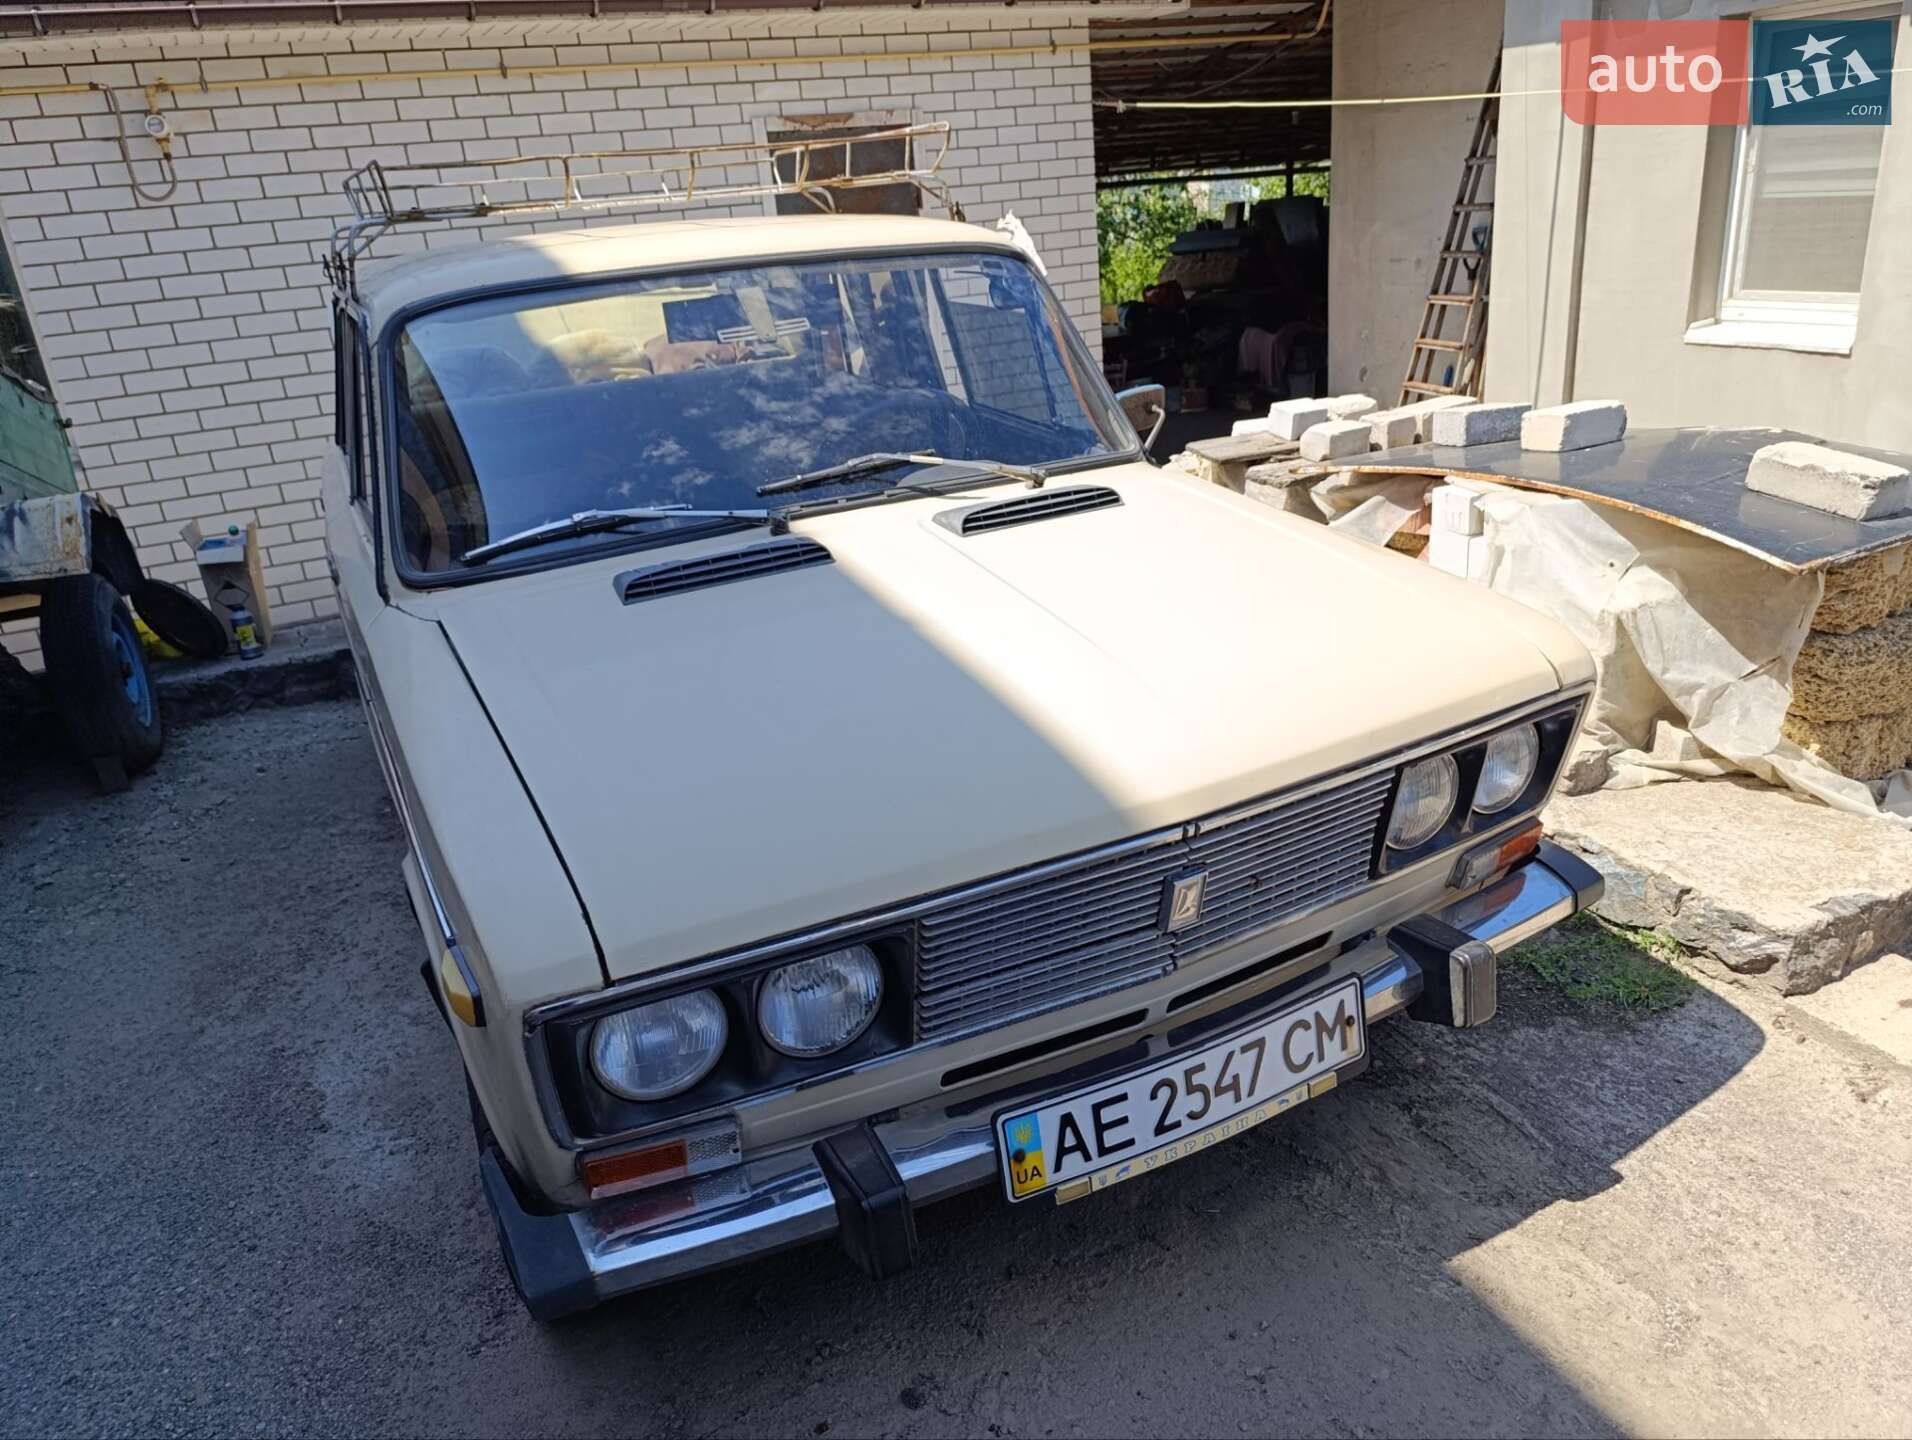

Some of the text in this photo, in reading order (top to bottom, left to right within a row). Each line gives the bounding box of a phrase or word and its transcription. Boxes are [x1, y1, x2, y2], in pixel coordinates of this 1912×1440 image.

[1053, 999, 1349, 1173] AE 2547 CM
[1016, 1165, 1043, 1185] UA
